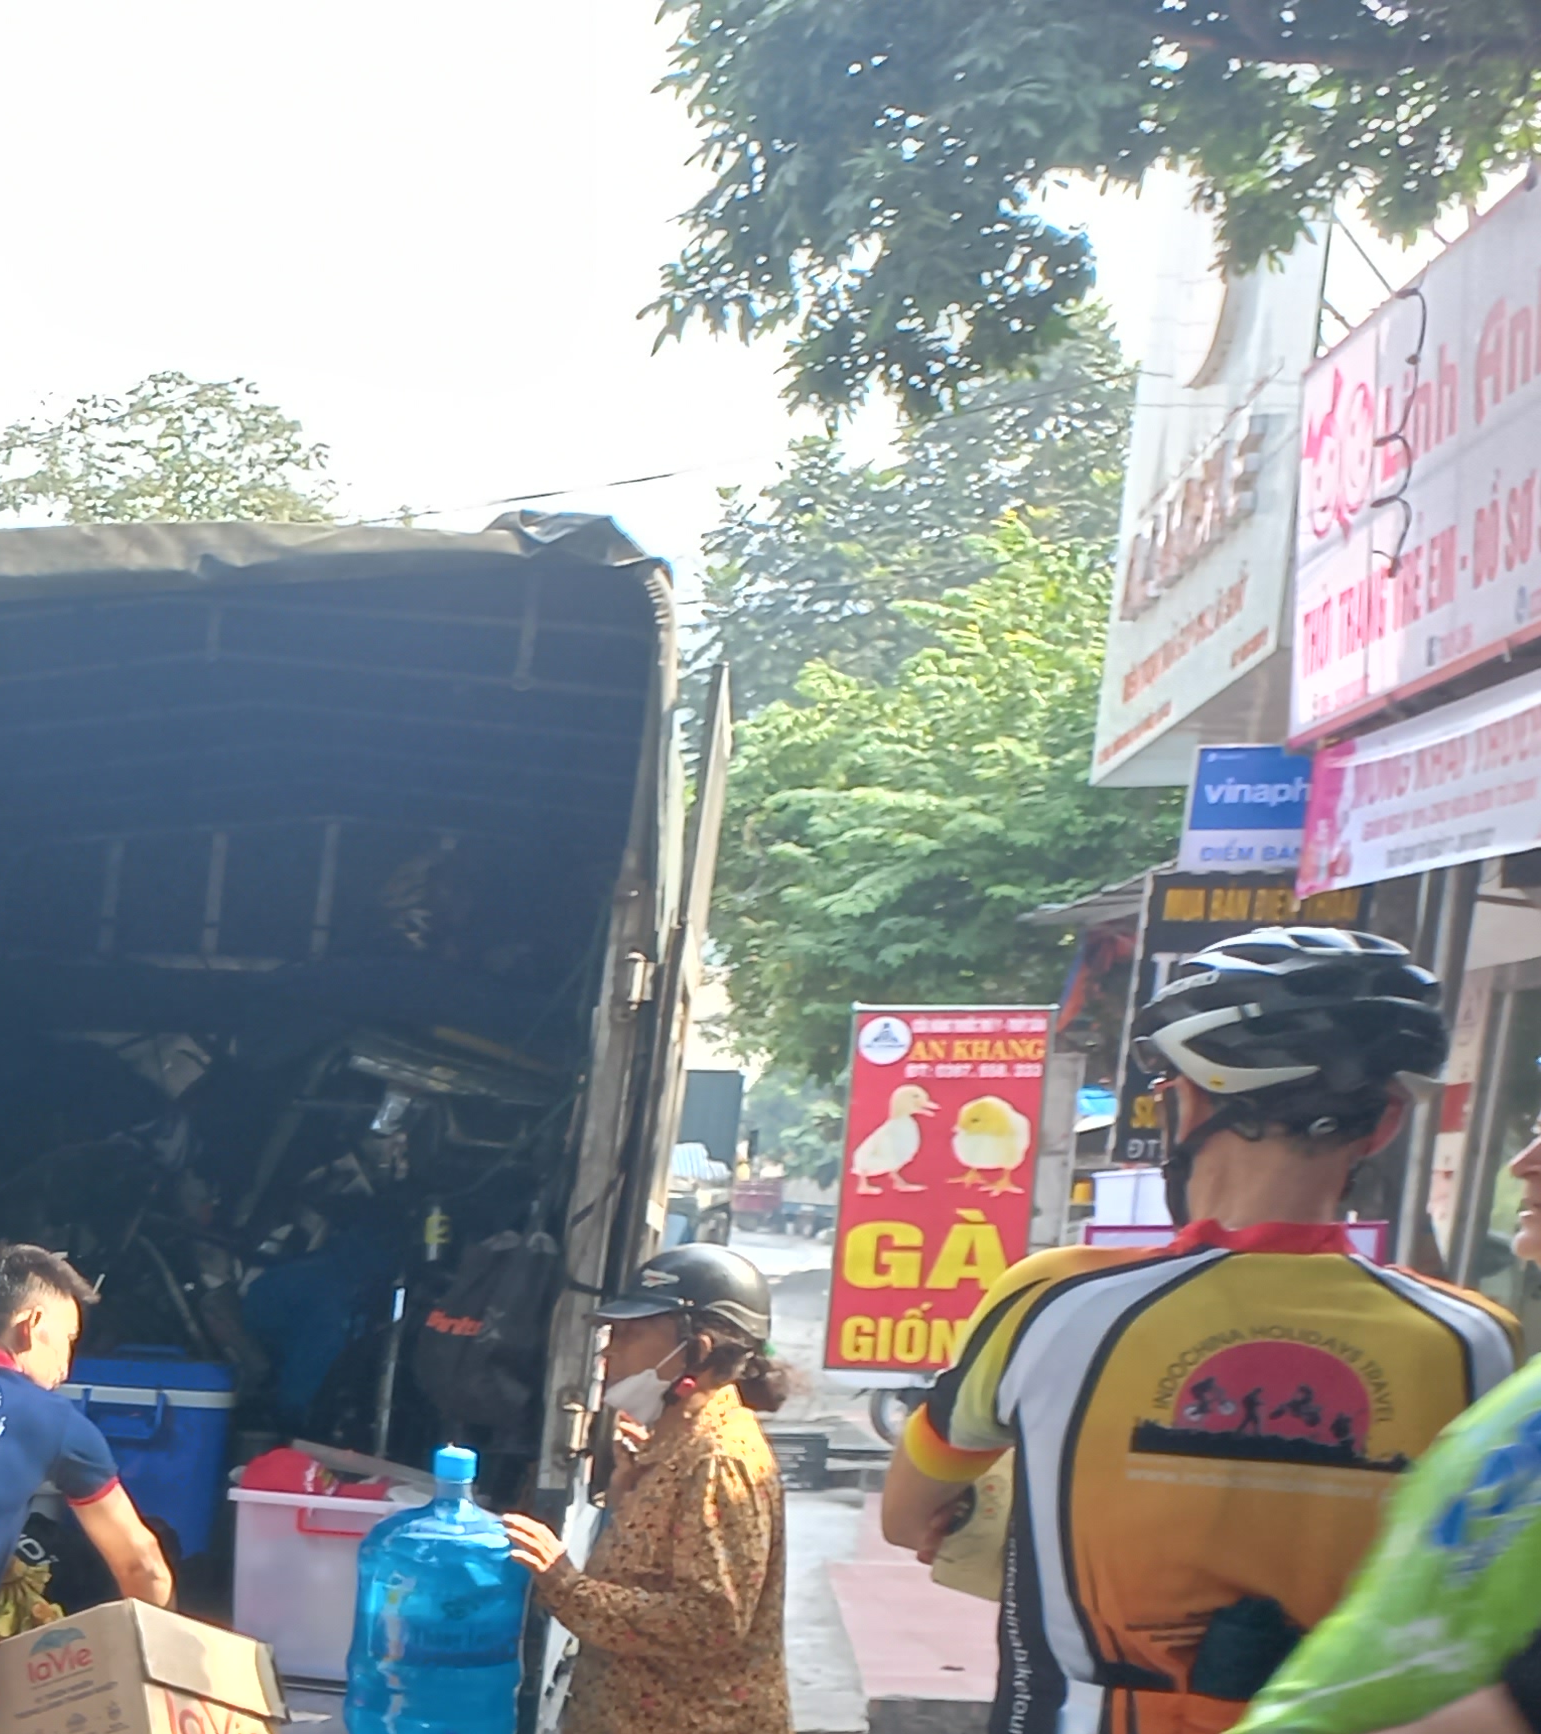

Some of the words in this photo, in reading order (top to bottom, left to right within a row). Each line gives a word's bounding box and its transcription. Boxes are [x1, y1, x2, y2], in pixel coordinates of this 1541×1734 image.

[1473, 265, 1541, 425] An
[909, 1039, 948, 1062] AN
[951, 1038, 1046, 1062] KHANG
[842, 1208, 1009, 1290] GÀ
